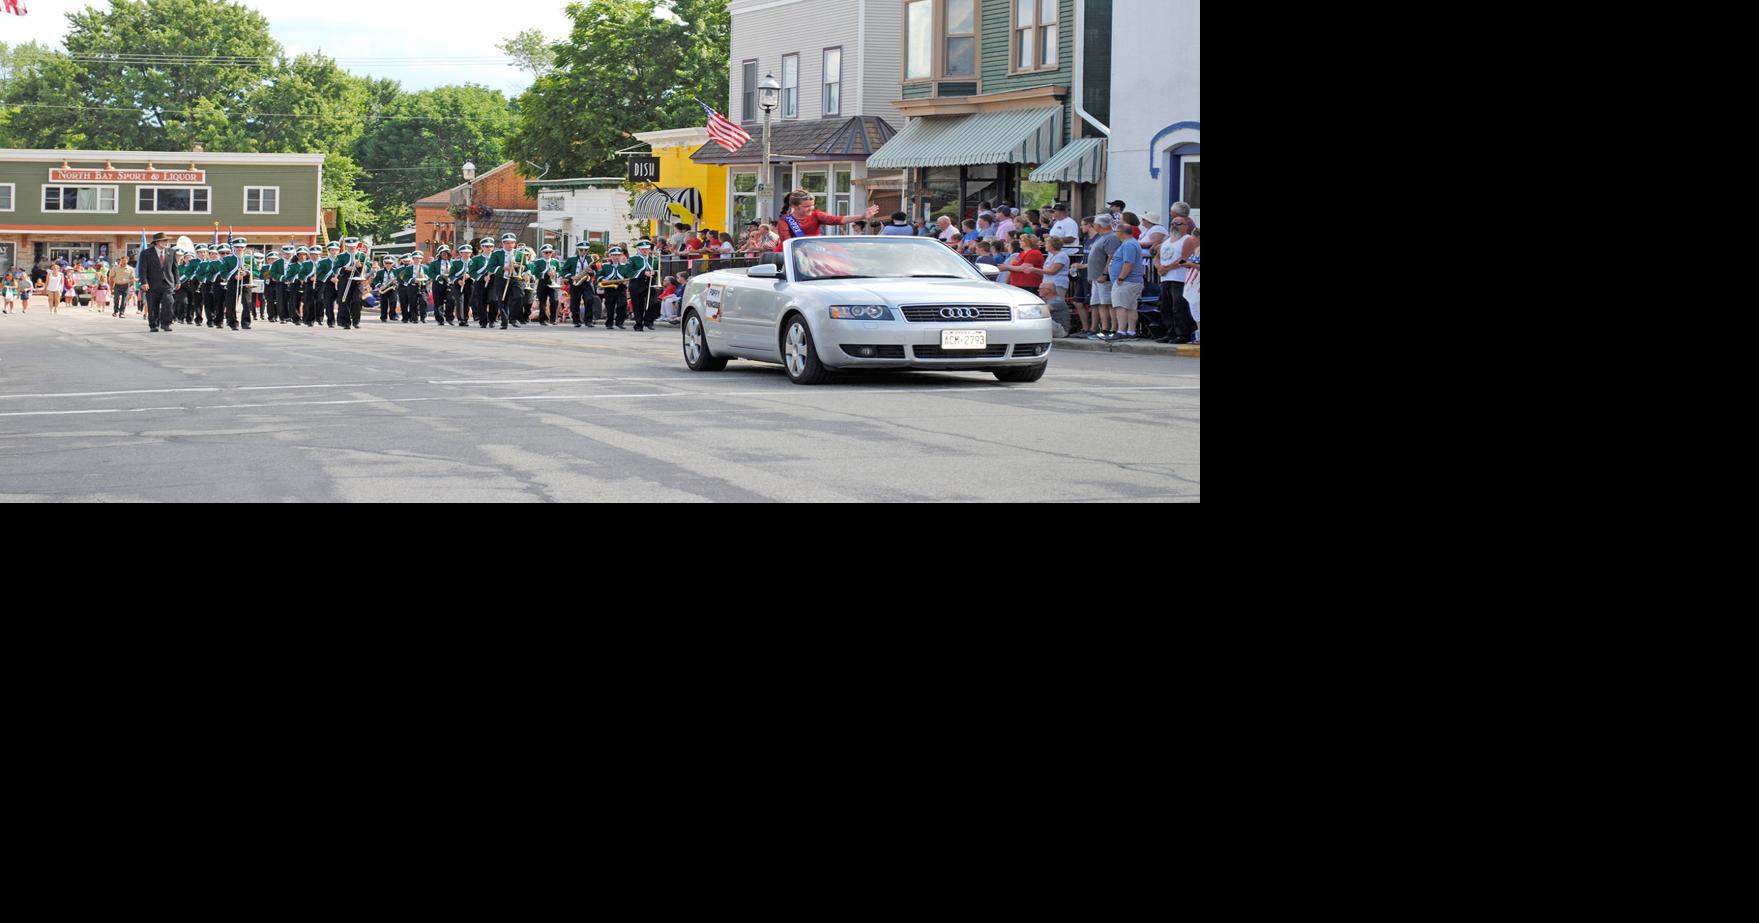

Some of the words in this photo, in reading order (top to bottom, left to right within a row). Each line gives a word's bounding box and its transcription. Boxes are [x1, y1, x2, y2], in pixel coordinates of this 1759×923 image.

[57, 170, 91, 180] NORTH
[95, 171, 112, 180] BAY
[117, 171, 147, 180] SPORT
[163, 172, 197, 182] LIQUOR
[634, 162, 655, 177] DISH
